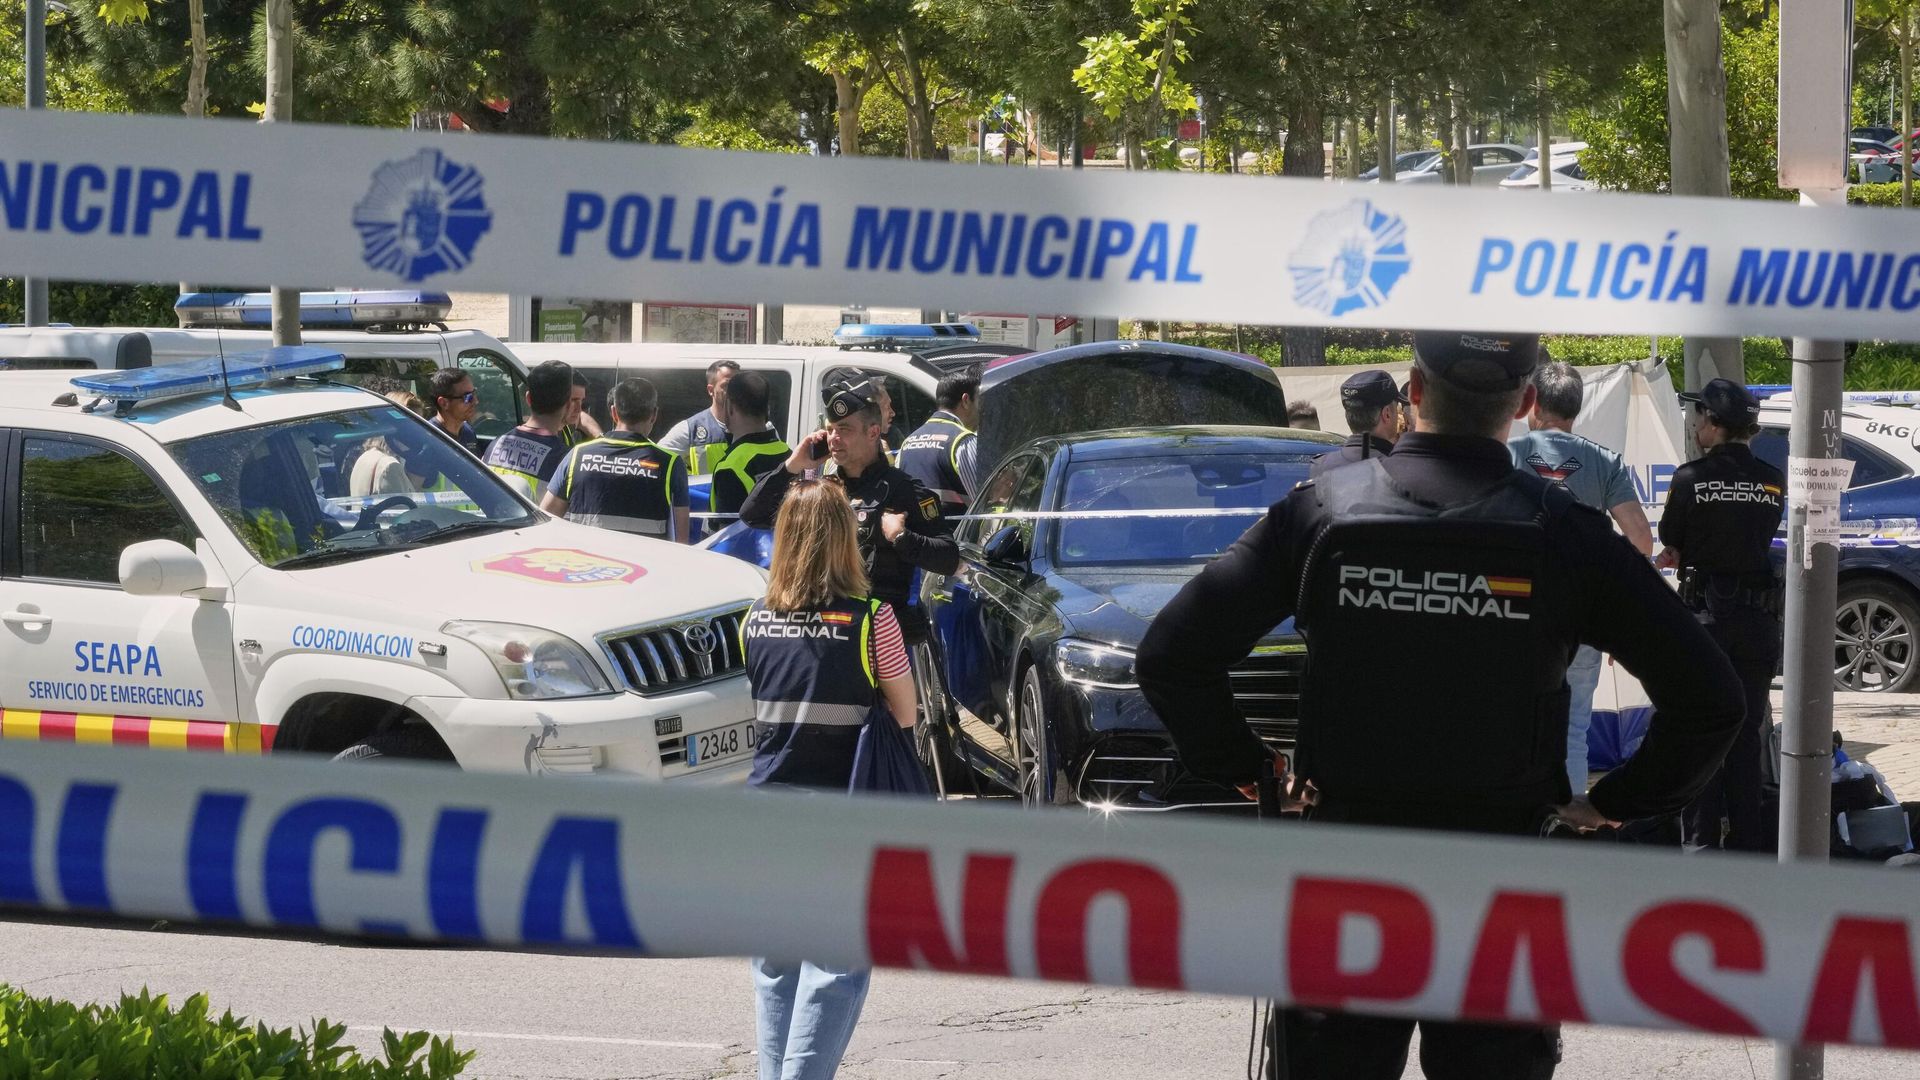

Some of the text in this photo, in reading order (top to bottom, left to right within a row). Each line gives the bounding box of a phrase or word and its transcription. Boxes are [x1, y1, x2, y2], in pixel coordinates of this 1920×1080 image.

[558, 188, 1203, 284] POLICÍA MUNICIPAL
[1470, 231, 1708, 303] POLICÍA
[1460, 340, 1509, 352] NACIONAL
[580, 463, 658, 479] NACIONAL
[582, 454, 641, 467] POLICIA
[1820, 468, 1829, 477] de
[1694, 481, 1765, 493] POLICIA
[1695, 491, 1779, 506] NACIONAL
[1340, 565, 1492, 595] POLICIA
[1339, 587, 1530, 620] NACIONAL
[749, 610, 823, 624] POLICIA
[292, 625, 413, 659] COORDINACION
[747, 625, 848, 641] NACIONAL
[75, 641, 162, 677] SEAPA
[28, 681, 204, 707] SERVICIO DE EMERGENCIAS
[700, 729, 738, 760] 2348
[864, 847, 1187, 991] NO
